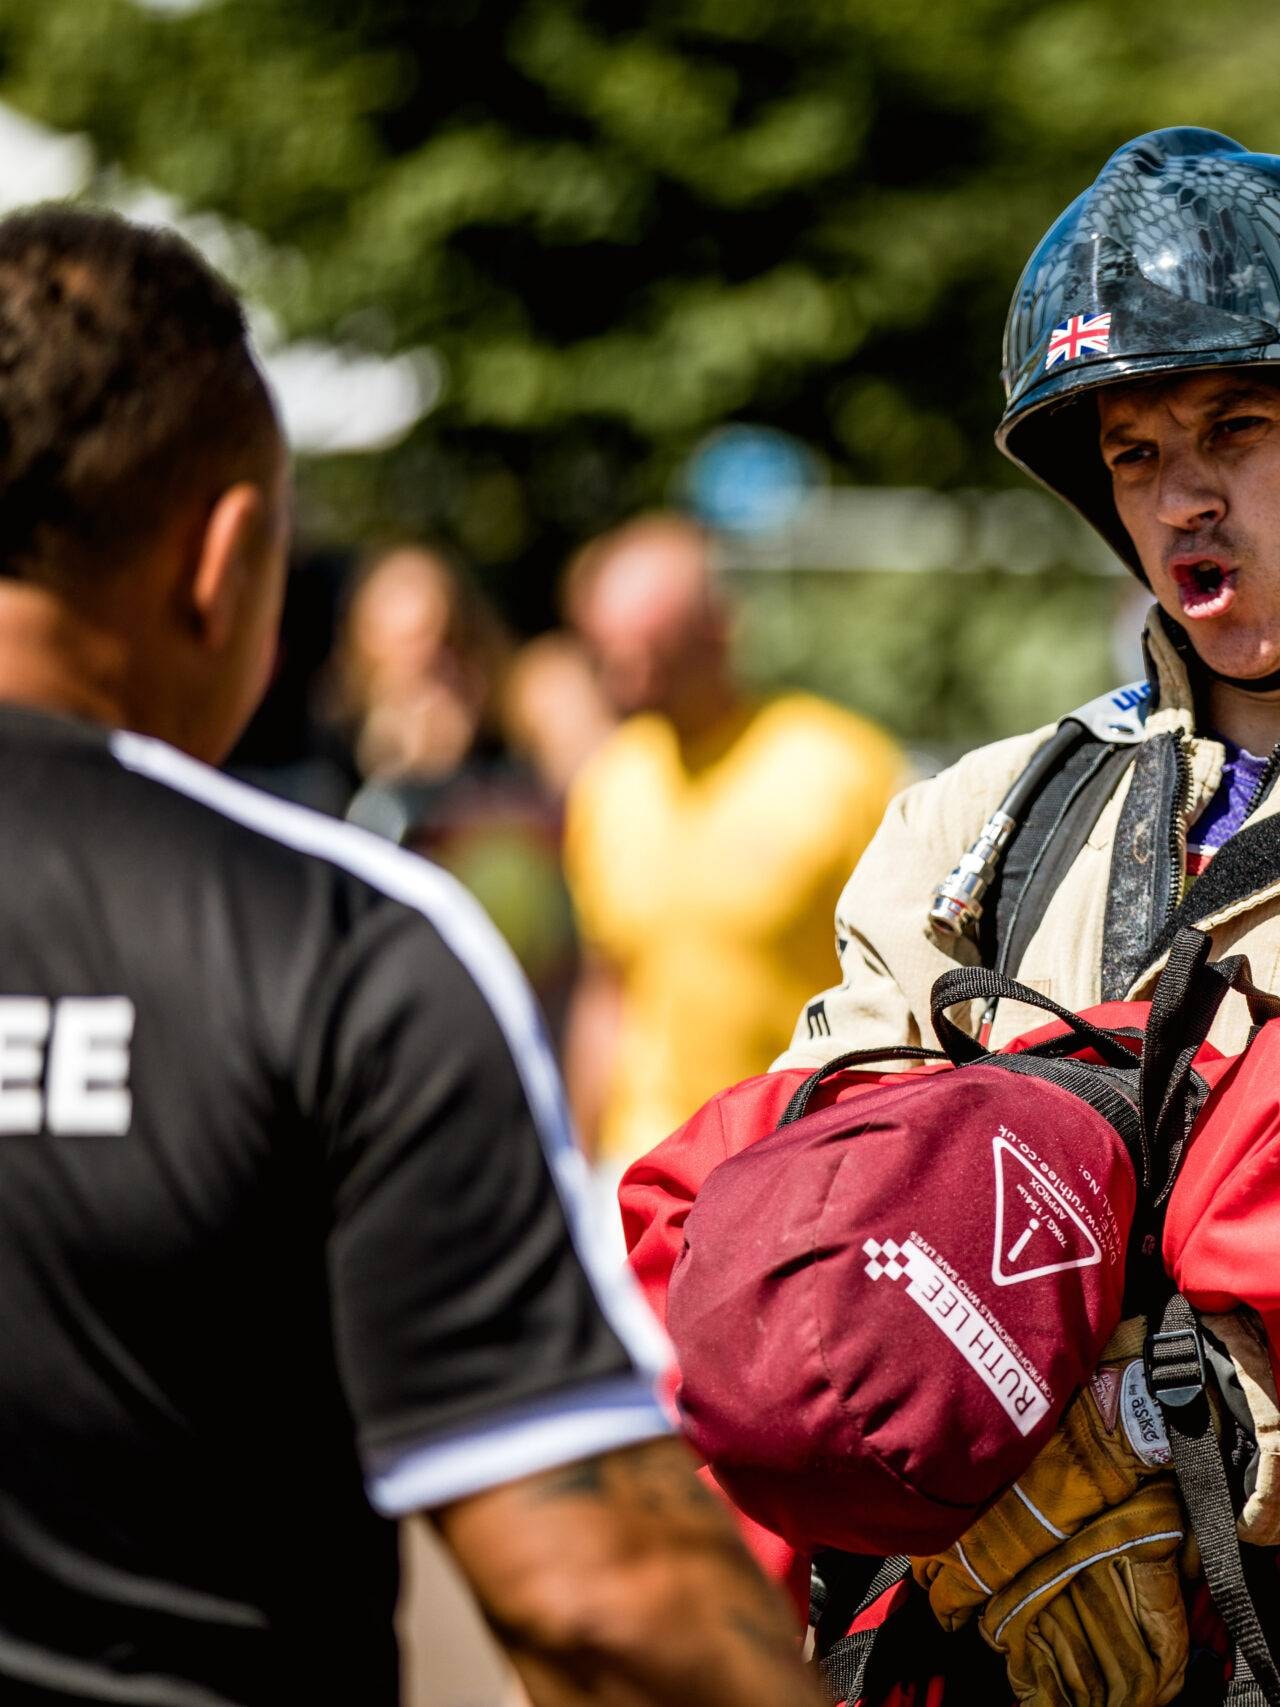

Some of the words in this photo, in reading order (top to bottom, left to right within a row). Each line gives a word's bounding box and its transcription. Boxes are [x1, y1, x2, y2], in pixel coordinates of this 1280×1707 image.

[0, 994, 135, 1137] EE
[998, 1124, 1107, 1252] www.ruthlee.co.uk
[1029, 1177, 1068, 1220] APPROX
[1078, 1165, 1100, 1195] No:
[909, 1230, 937, 1258] LIVES
[1046, 1219, 1068, 1249] 70KG
[934, 1255, 959, 1283] SAVE
[921, 1275, 970, 1331] LEE
[957, 1279, 981, 1307] WHO
[979, 1304, 1041, 1384] PROFESSIONALS
[969, 1329, 1037, 1416] RUTH
